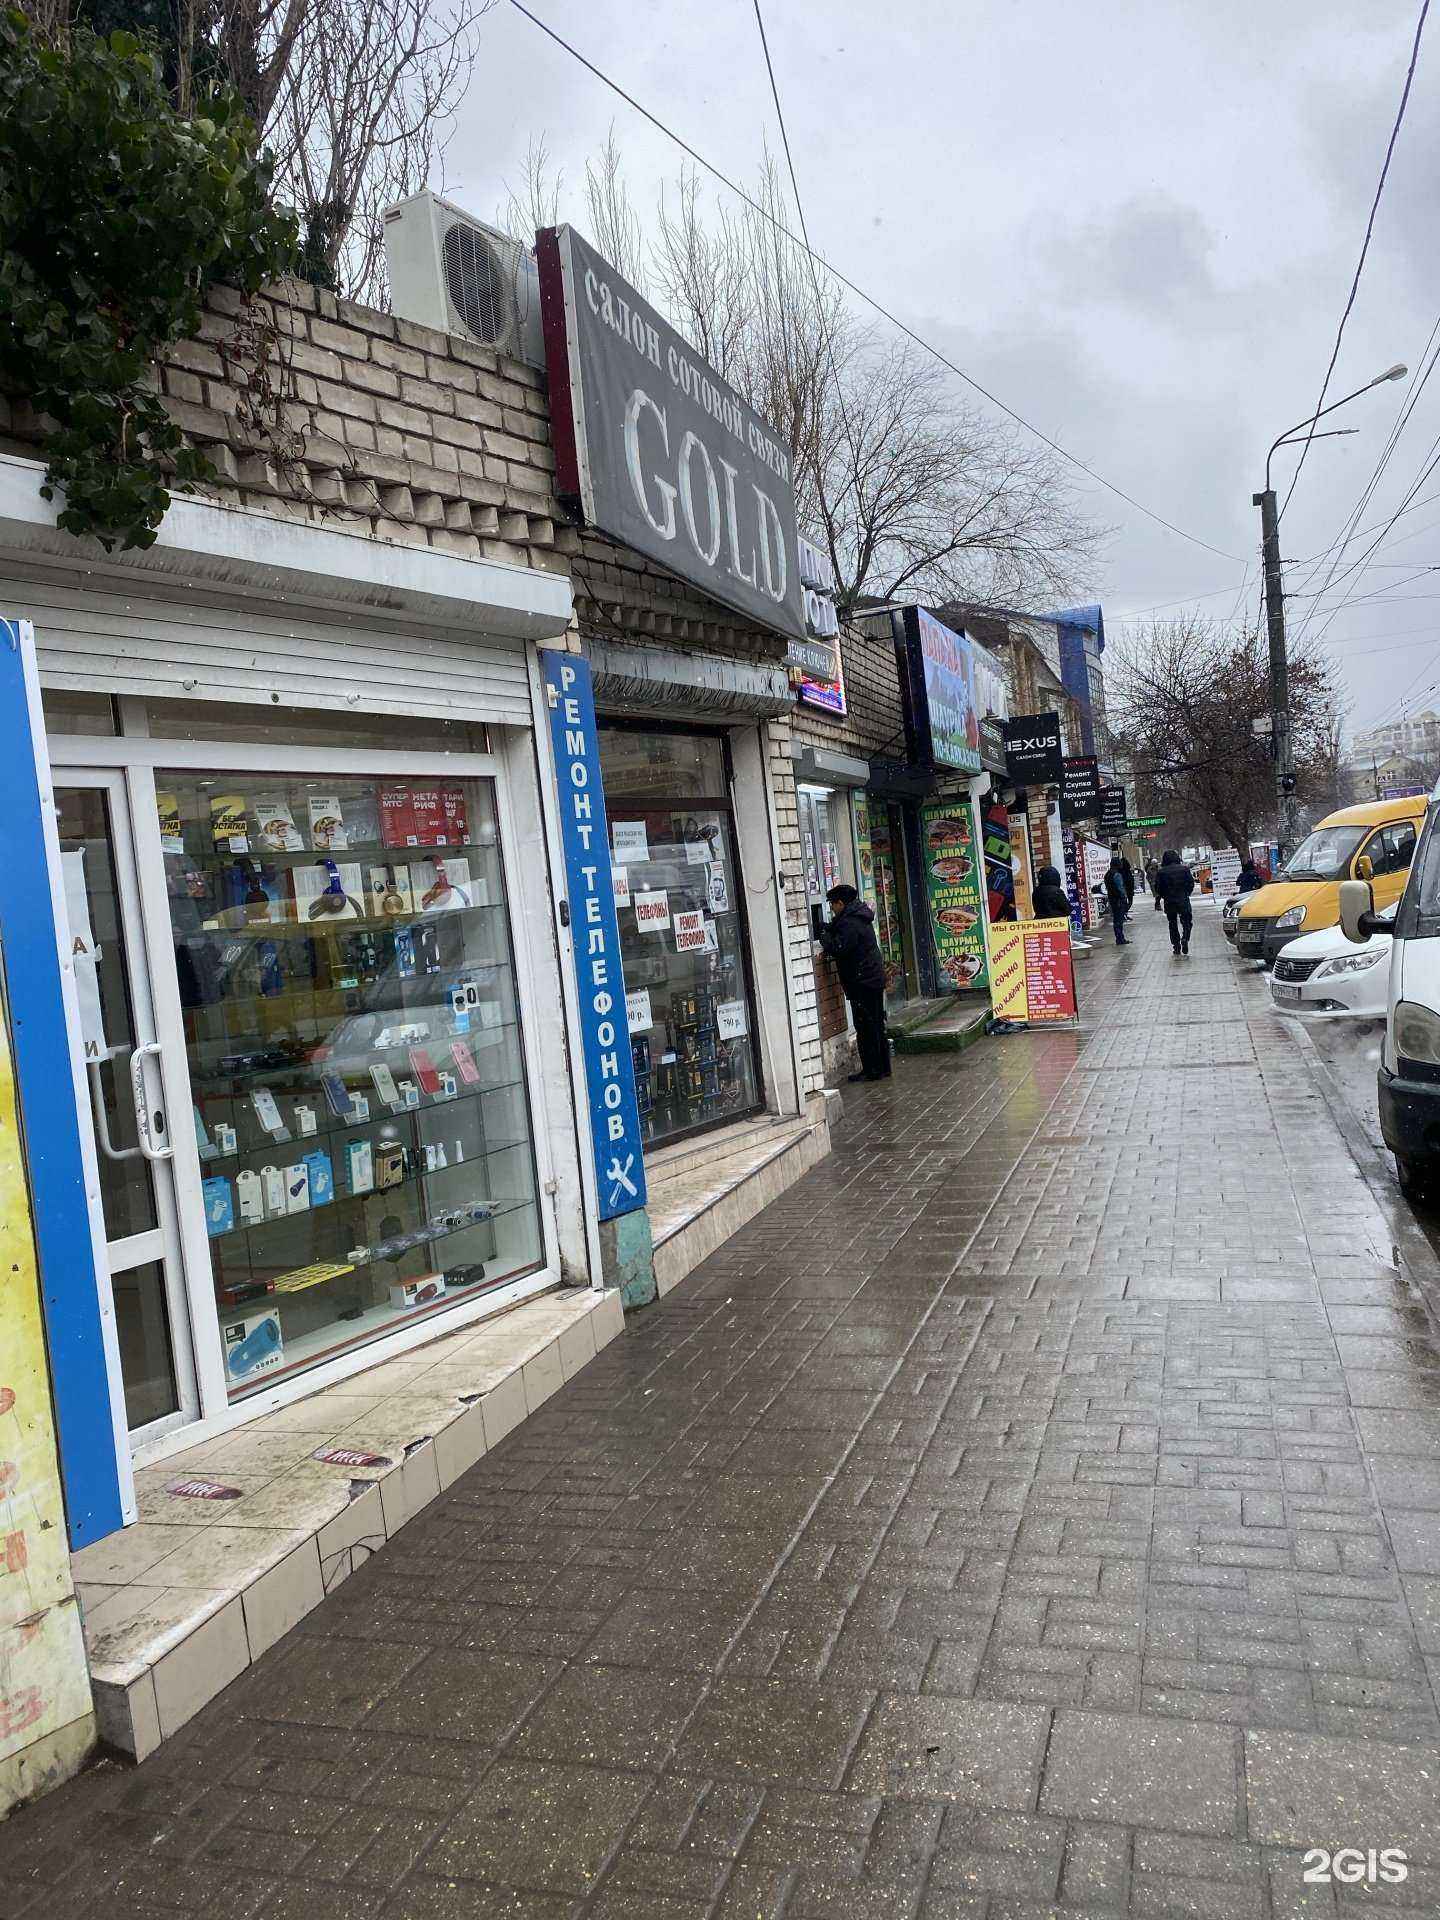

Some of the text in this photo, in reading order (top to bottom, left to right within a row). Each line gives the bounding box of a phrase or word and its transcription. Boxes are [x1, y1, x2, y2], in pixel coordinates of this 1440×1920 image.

[624, 388, 787, 603] GOLD
[1065, 781, 1092, 789] Скупка
[382, 792, 409, 800] СУПЕР
[1063, 790, 1096, 799] Продажа
[382, 800, 404, 808] МТС
[1074, 800, 1087, 808] Б/У
[925, 808, 968, 820] ШАУРМА
[213, 822, 246, 831] ОСТАТКА
[935, 886, 975, 898] ШАУРМА
[560, 665, 625, 1142] РЕМОНТ ТЕЛЕФОНОВ
[941, 895, 981, 907] БУЛОЧКЕ
[637, 902, 668, 920] ТЕЛЕФОНЫ
[679, 914, 699, 930] РЕМОНТ
[1009, 920, 1066, 931] ОТКРЫЛИСЬ
[677, 929, 706, 949] ТЕЛЕФОНОВ
[941, 936, 978, 947] ШАУРМА
[951, 944, 985, 957] ТАРЕЛКЕ
[992, 935, 1020, 965] ВКУСНО
[994, 961, 1019, 987] СОЧНО
[993, 978, 1025, 1016] ПО КАЙФУ
